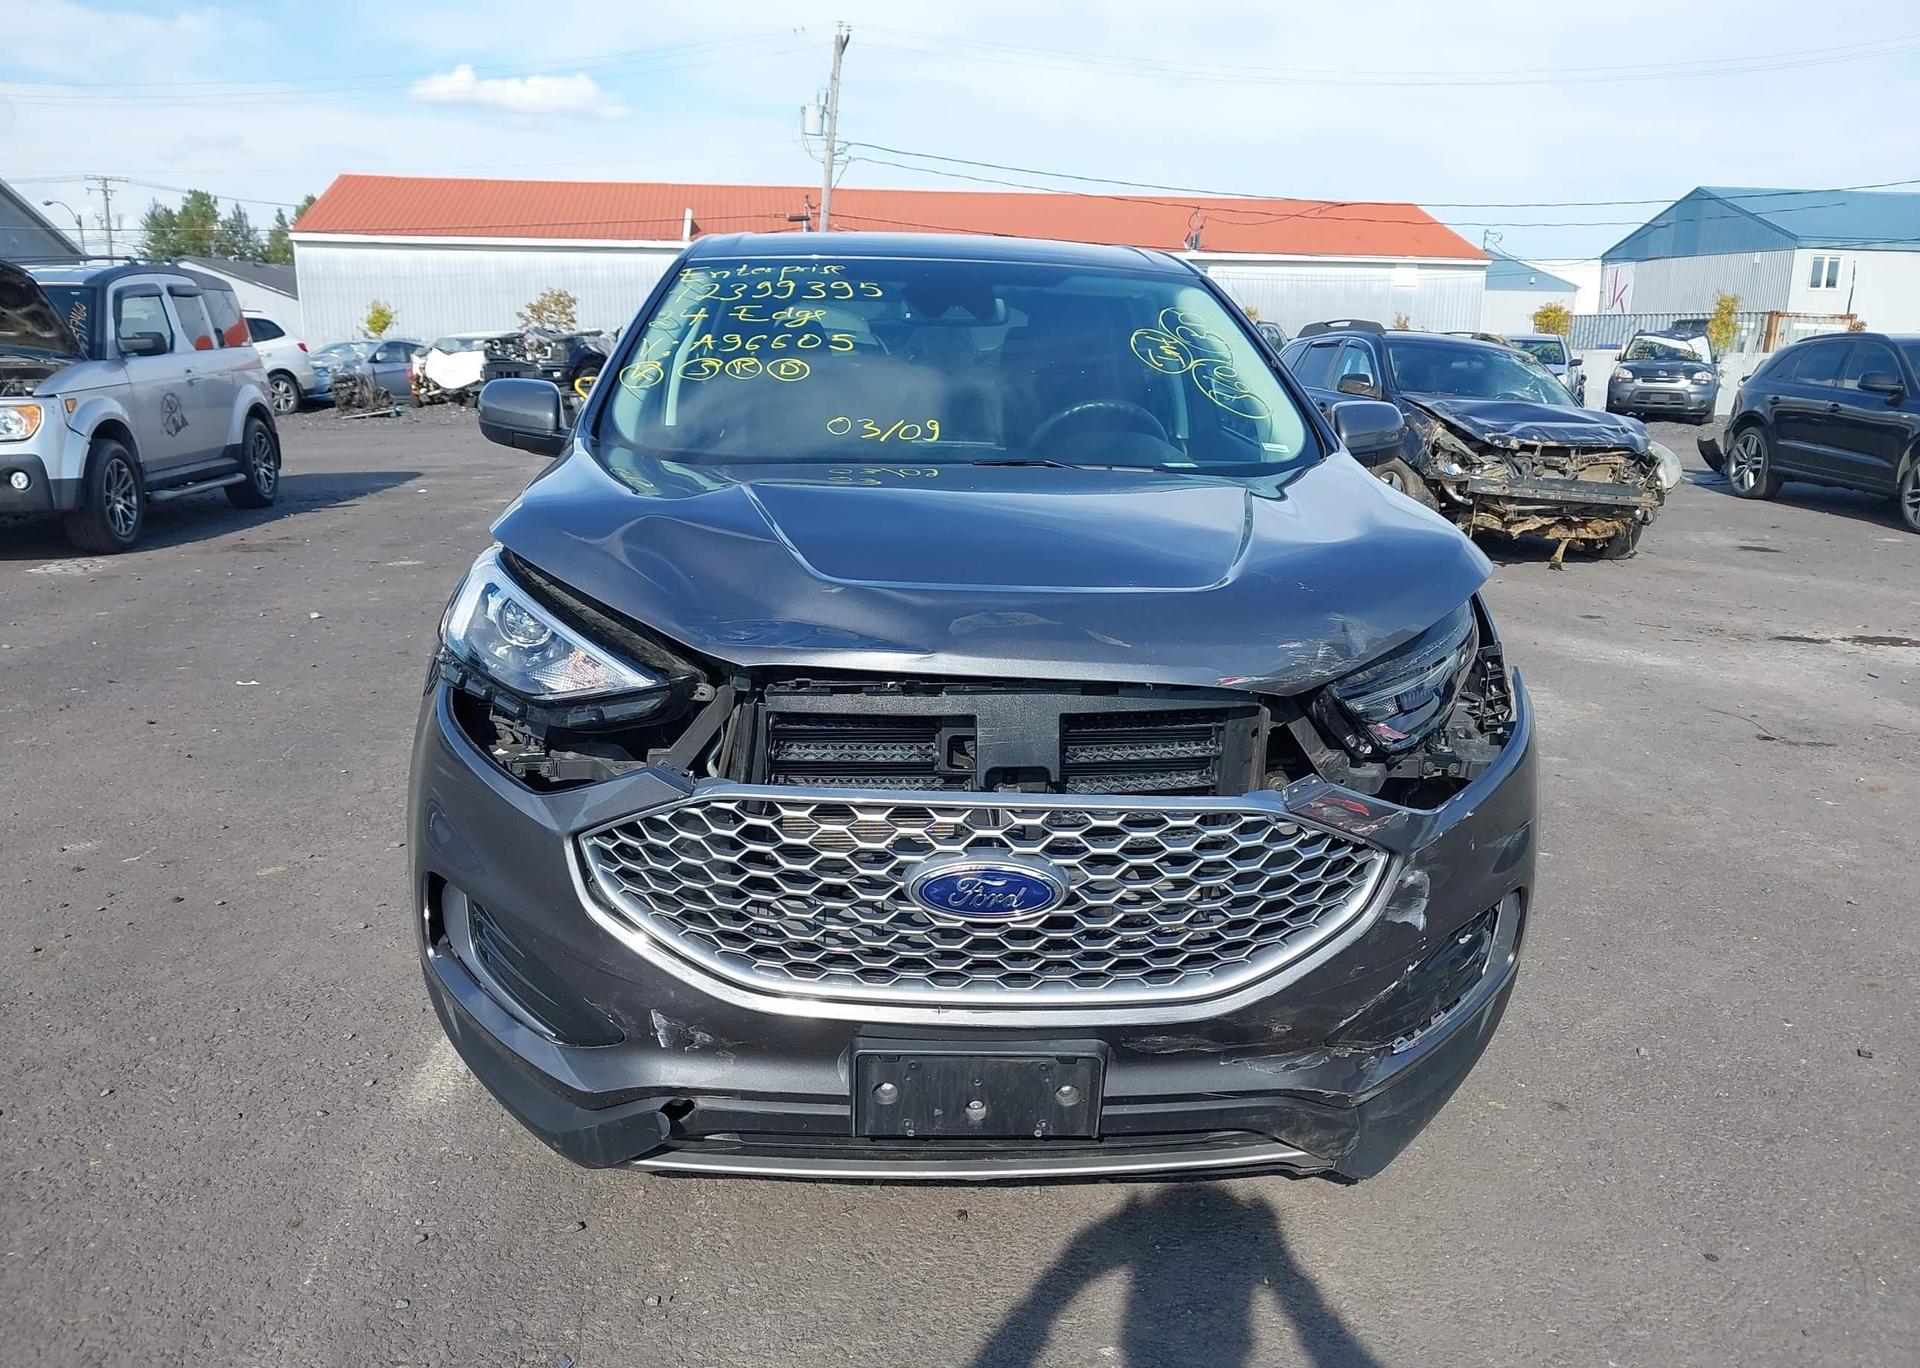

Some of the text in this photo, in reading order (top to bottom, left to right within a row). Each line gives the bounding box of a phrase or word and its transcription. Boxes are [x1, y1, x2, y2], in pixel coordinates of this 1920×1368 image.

[728, 304, 827, 328] Edge
[826, 416, 940, 442] 03/09
[948, 877, 1028, 908] Ford
